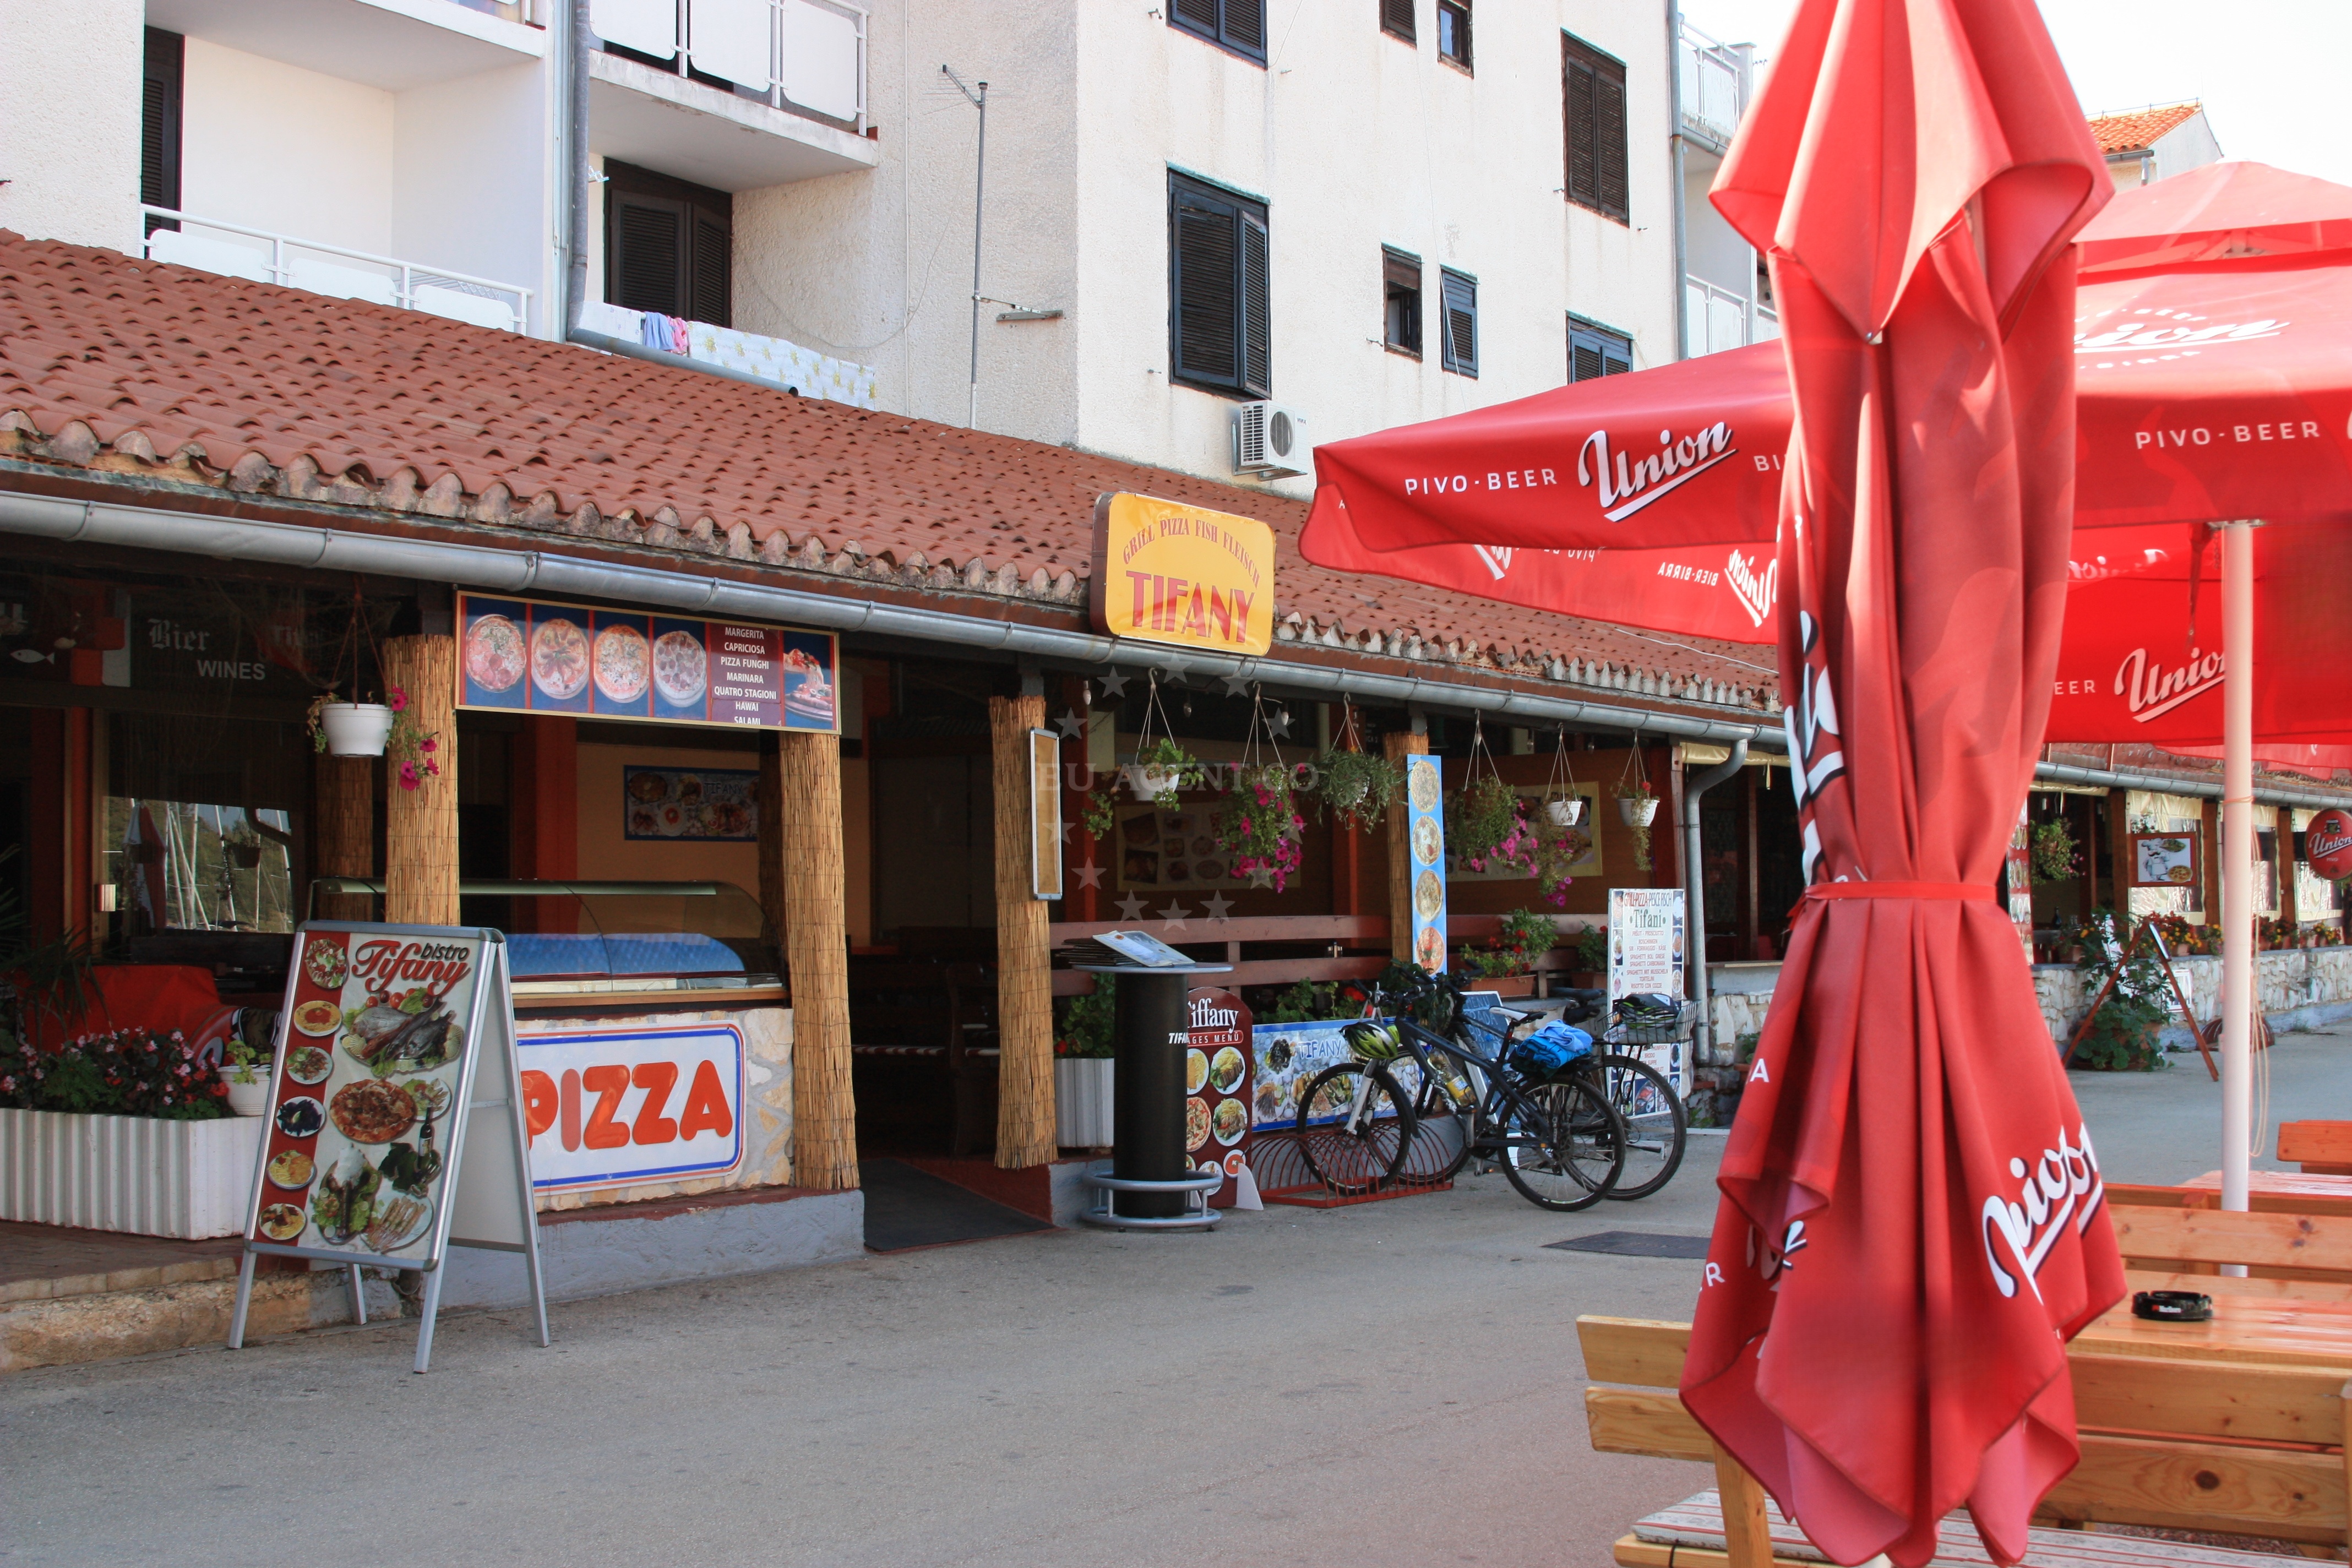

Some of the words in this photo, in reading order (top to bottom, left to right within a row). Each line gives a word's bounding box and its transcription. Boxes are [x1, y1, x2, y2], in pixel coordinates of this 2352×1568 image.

[1577, 421, 1734, 509] Union
[1123, 524, 1155, 565] GRILL
[1159, 518, 1190, 537] PIZZA
[1195, 519, 1218, 544] FISH
[1222, 531, 1260, 589] FLEISCH
[1126, 570, 1255, 643] TIFANY
[148, 618, 211, 652] Bier
[725, 627, 764, 640] MARGERITA
[724, 641, 765, 655] CAPRICIOSA
[197, 659, 266, 680] WINES
[721, 656, 741, 667] PIZZA
[743, 658, 769, 669] FUNGHI
[727, 672, 764, 684] MARINARA
[2114, 647, 2224, 712] Unio
[714, 685, 743, 697] QUATRO
[744, 688, 777, 700] STAGIONI
[735, 701, 759, 711] HAWAI
[734, 716, 760, 725] SALAMI
[704, 782, 743, 795] TIFANY
[1634, 909, 1662, 928] Tifani
[352, 939, 471, 998] Tifany
[421, 943, 470, 961] bistro
[1188, 998, 1239, 1033] iffany
[1214, 1031, 1239, 1043] MENÜ
[1298, 1039, 1342, 1059] TIFANY
[520, 1059, 733, 1152] PIZZA
